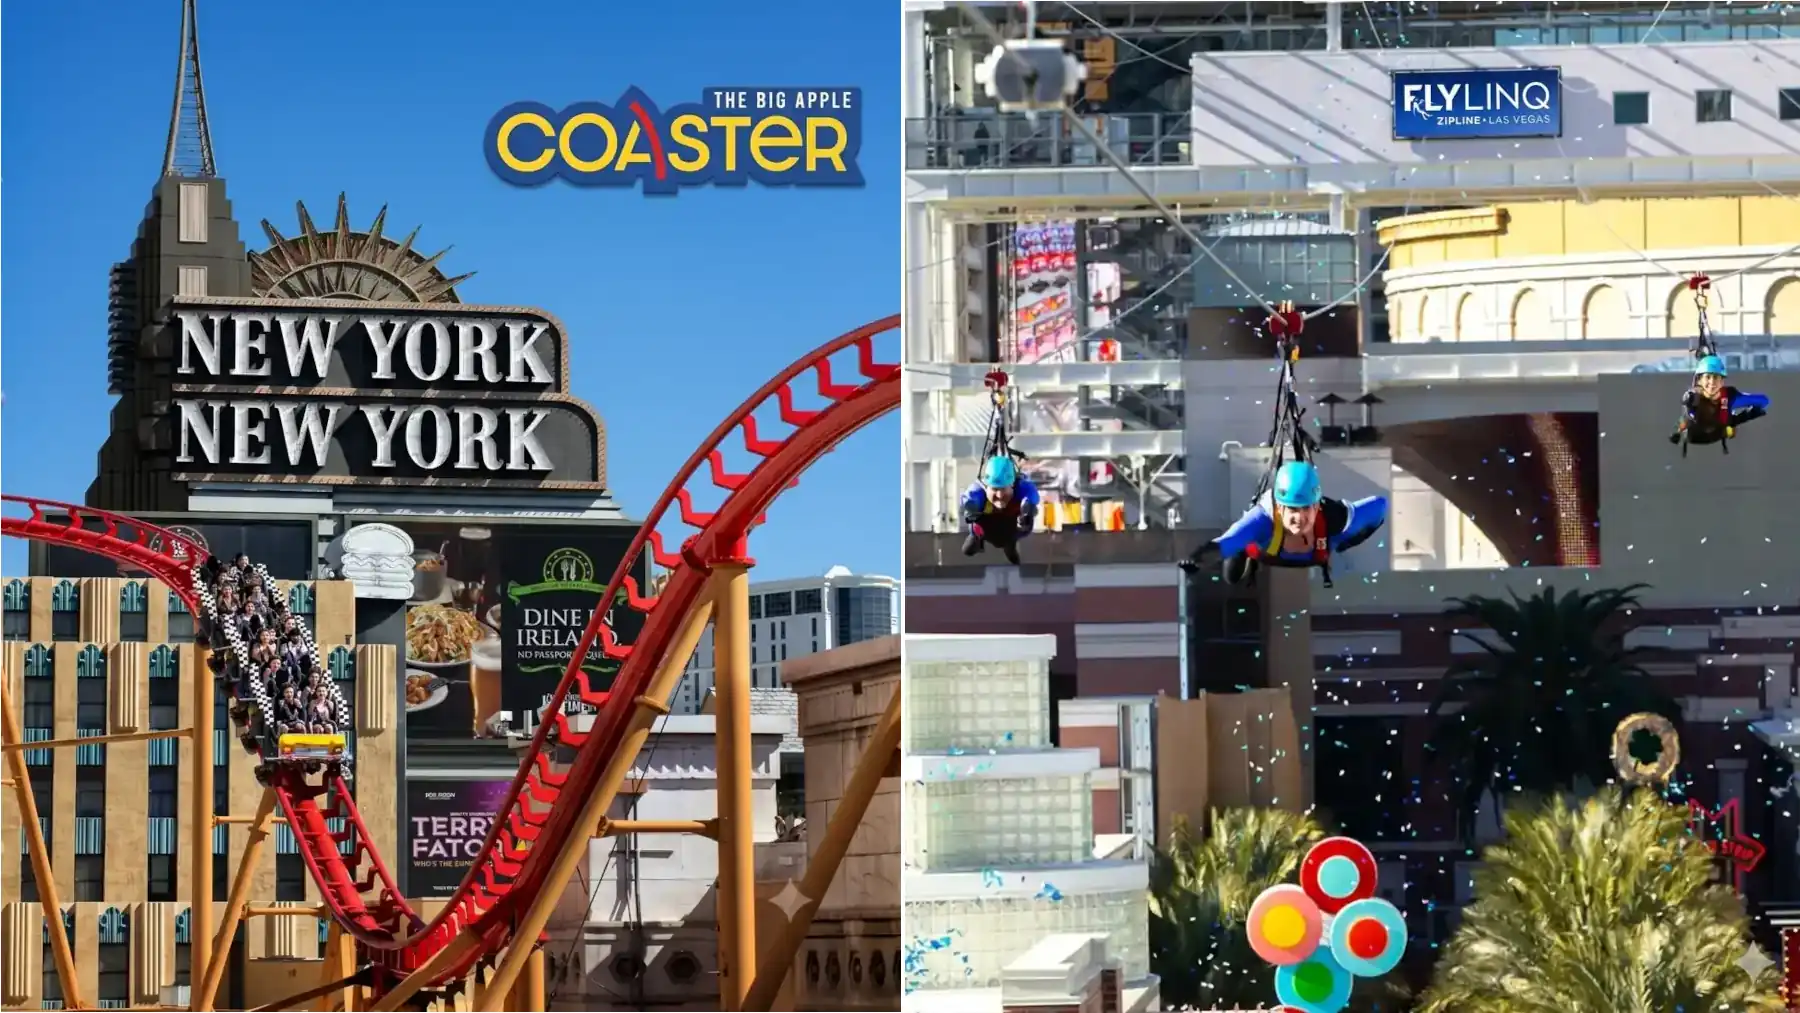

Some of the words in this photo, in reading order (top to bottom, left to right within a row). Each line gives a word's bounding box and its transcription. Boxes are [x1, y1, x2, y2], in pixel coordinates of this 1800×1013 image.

[1404, 81, 1550, 112] FLYLINQ
[1436, 116, 1481, 126] ZIPLINE
[1489, 116, 1510, 125] LAS
[1513, 115, 1550, 124] VEGAS
[176, 312, 341, 377] NEW
[359, 318, 555, 384] YORK
[176, 400, 341, 467] NEW
[359, 404, 555, 471] YORK
[524, 608, 582, 626] DINE
[534, 650, 573, 659] PASSPOR
